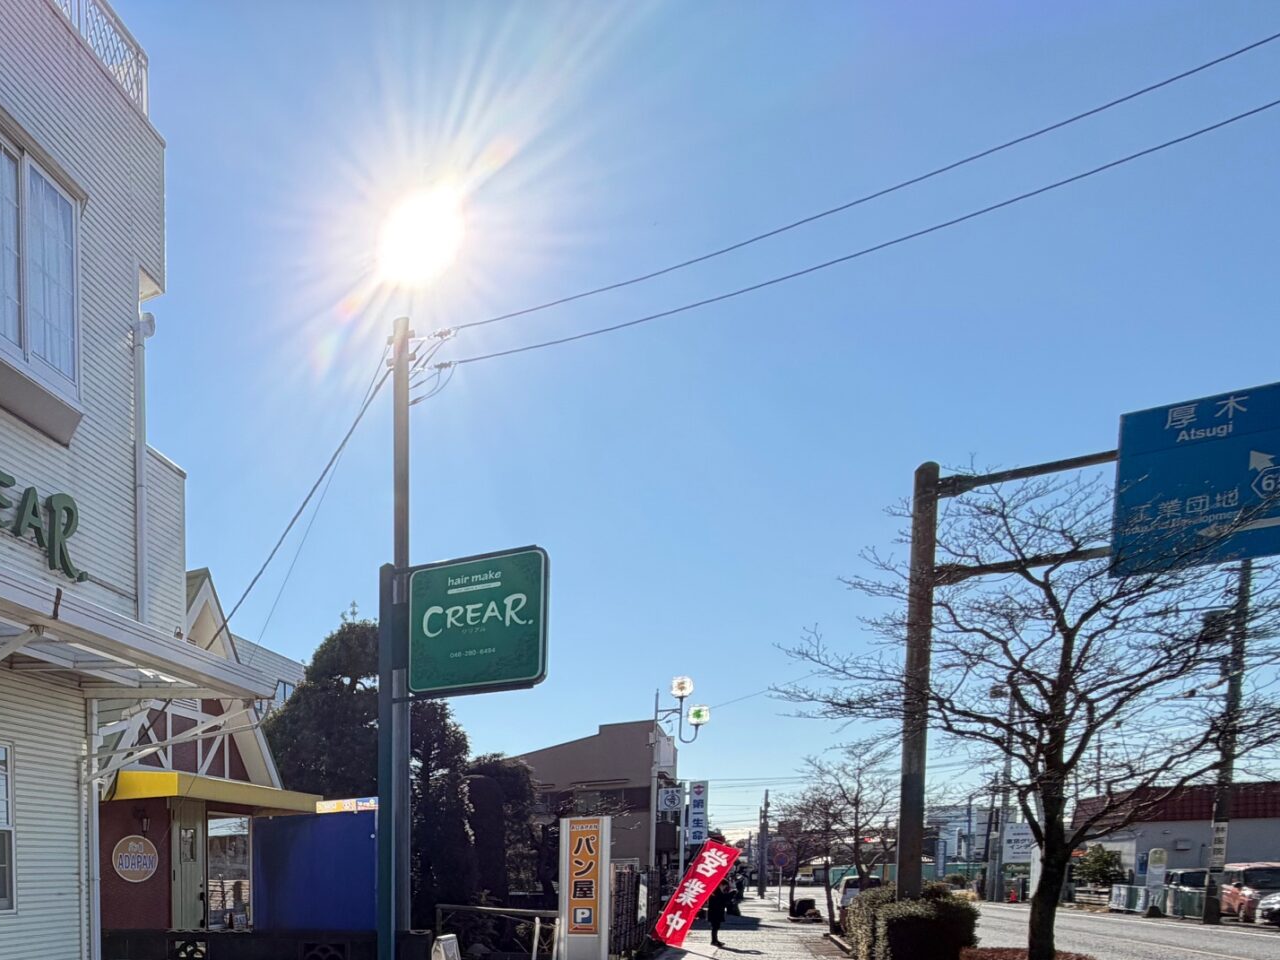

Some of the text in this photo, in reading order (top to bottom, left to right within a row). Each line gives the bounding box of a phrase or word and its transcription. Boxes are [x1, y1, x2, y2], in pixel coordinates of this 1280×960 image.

[1164, 396, 1249, 430] 厚木
[1176, 421, 1233, 443] Atsugi
[448, 570, 502, 587] hair make
[692, 799, 705, 841] 第一生命
[118, 853, 156, 871] ADAPAN
[572, 836, 597, 900] パン屋
[666, 847, 729, 938] 営業中
